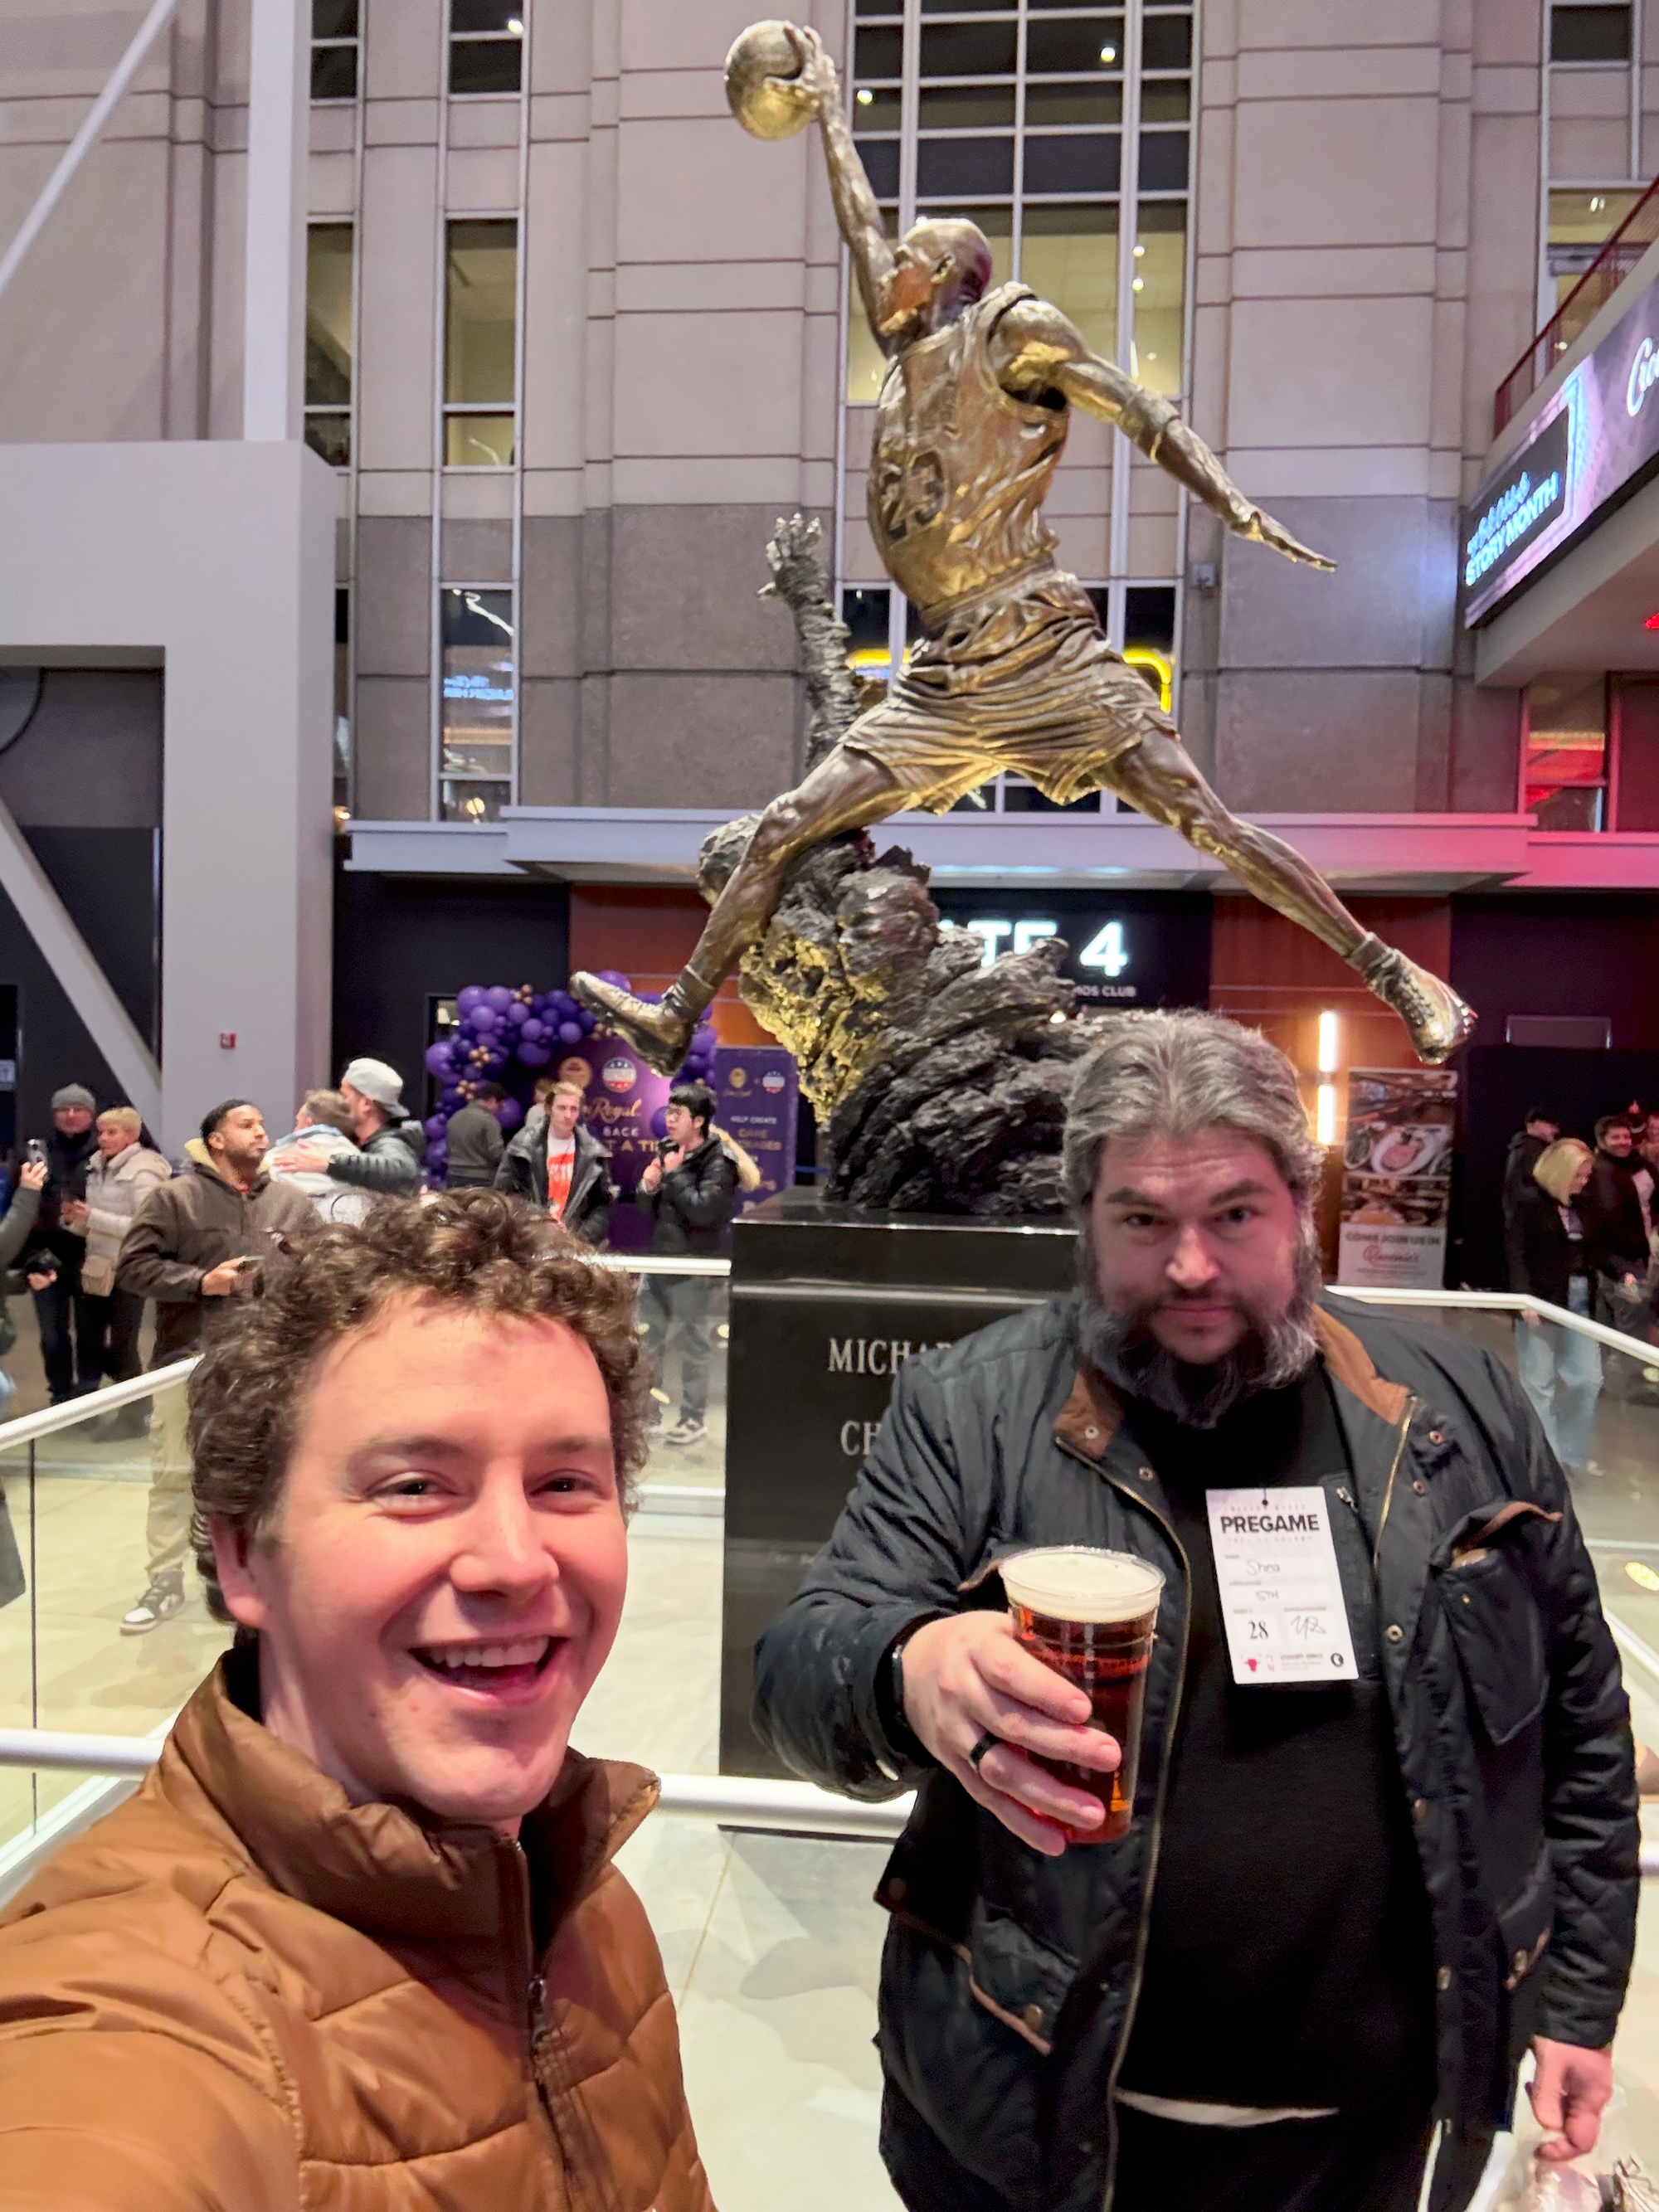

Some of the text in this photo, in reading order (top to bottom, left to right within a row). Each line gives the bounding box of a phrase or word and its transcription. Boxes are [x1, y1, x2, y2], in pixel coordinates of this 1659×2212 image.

[1079, 918, 1128, 977] 4
[1102, 984, 1136, 998] CLUB
[602, 1126, 640, 1138] BACK
[828, 1338, 953, 1375] MICH
[1220, 1513, 1321, 1534] PREGAME
